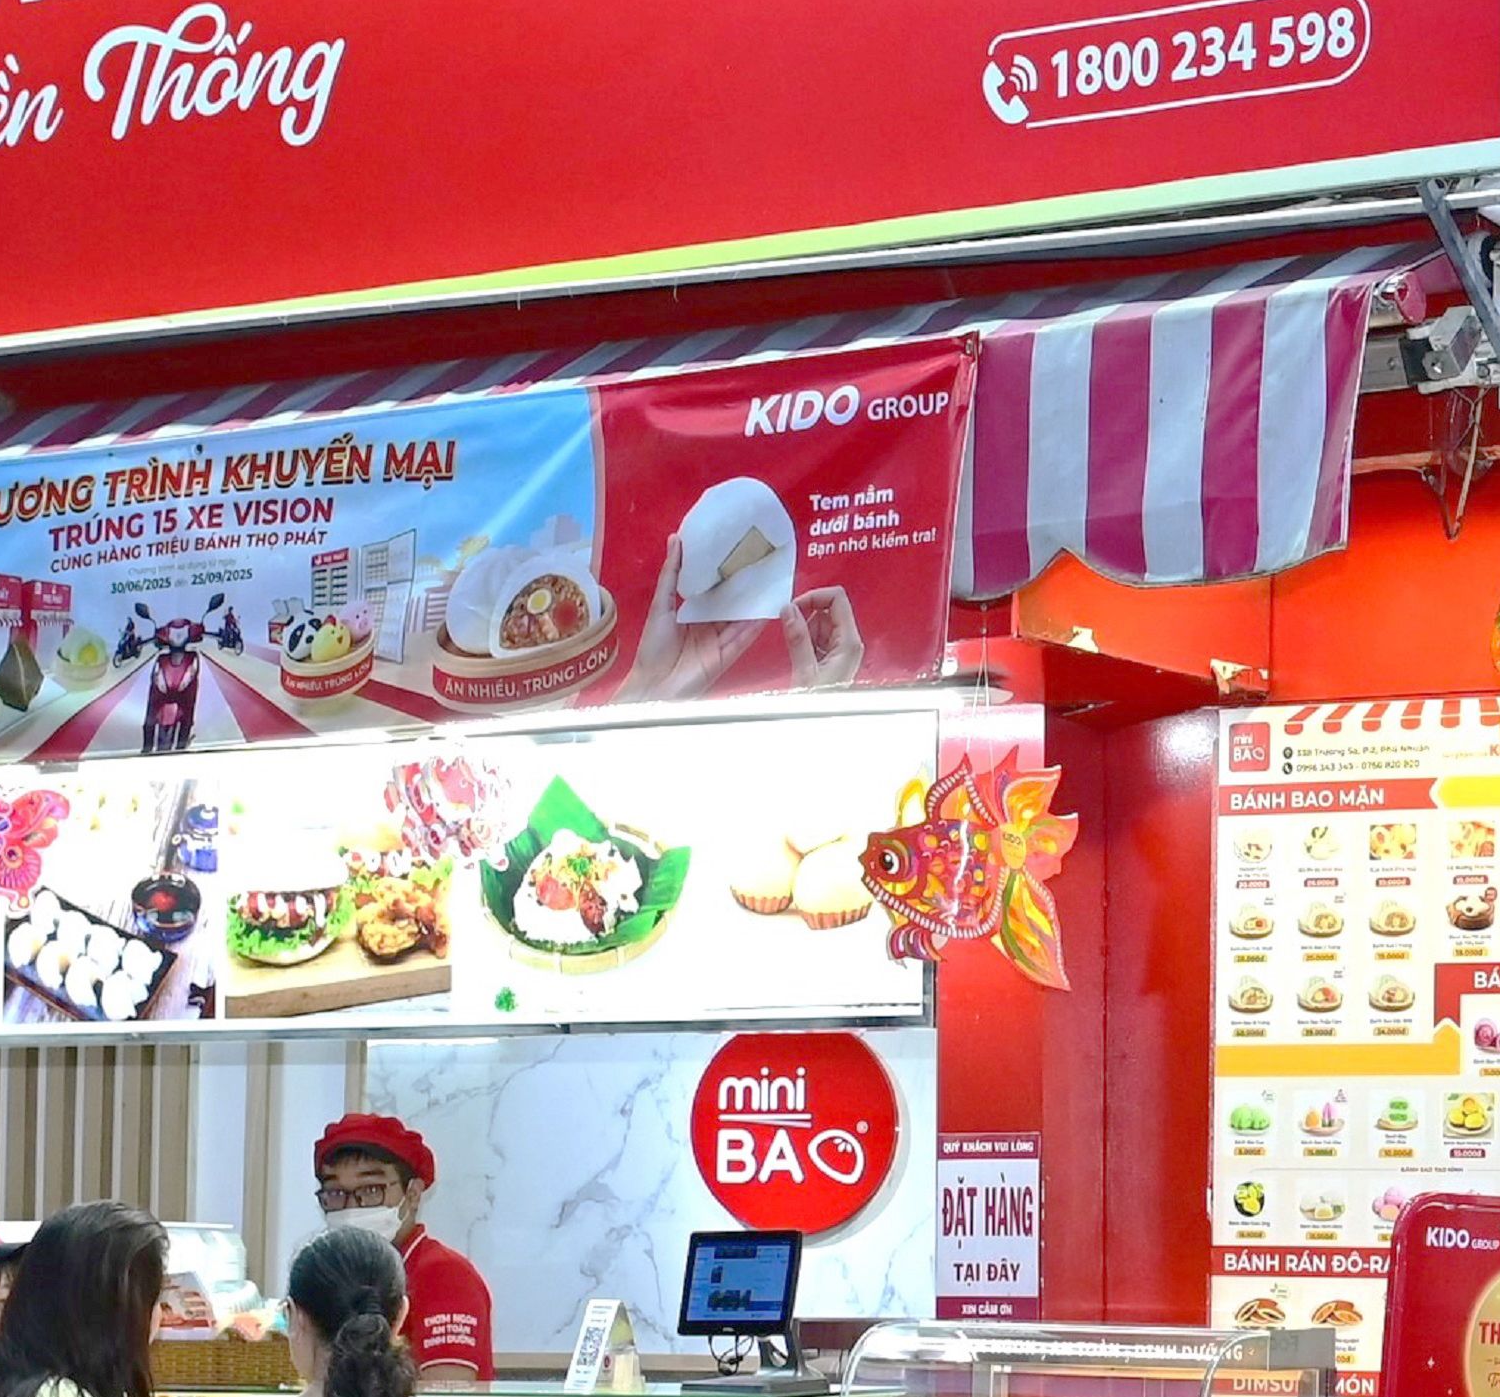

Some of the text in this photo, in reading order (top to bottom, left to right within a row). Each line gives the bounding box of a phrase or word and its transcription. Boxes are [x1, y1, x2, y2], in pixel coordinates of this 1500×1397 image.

[1051, 7, 1357, 99] 1800 234 598
[83, 2, 345, 146] Thống
[742, 384, 950, 438] KIDO GROUP
[106, 455, 215, 508] TRÌNH
[222, 432, 372, 493] KHUYẾN
[383, 440, 456, 492] MẠI
[809, 494, 849, 511] Tem
[853, 509, 900, 530] bánh
[49, 497, 334, 552] TRÚNG 15 XE VISION
[51, 548, 91, 574] CÙNG
[96, 542, 142, 568] HÀNG
[146, 535, 190, 559] TRIỆU
[194, 530, 241, 552] BÁNH
[246, 531, 279, 550] THỌ
[284, 528, 327, 546] PHÁT
[807, 542, 835, 559] Bạn
[872, 532, 908, 549] kiểm
[110, 569, 253, 595] 30/06/2025 25/09/2025
[1230, 786, 1385, 810] BÁNH BAO MẶN
[718, 1067, 805, 1111] mini
[942, 1172, 1034, 1249] ĐẶT HÀNG
[1426, 1227, 1500, 1250] KIDO GROUP
[954, 1259, 1021, 1286] TẠI ĐÂY
[1223, 1249, 1325, 1272] BÁNH RÁN
